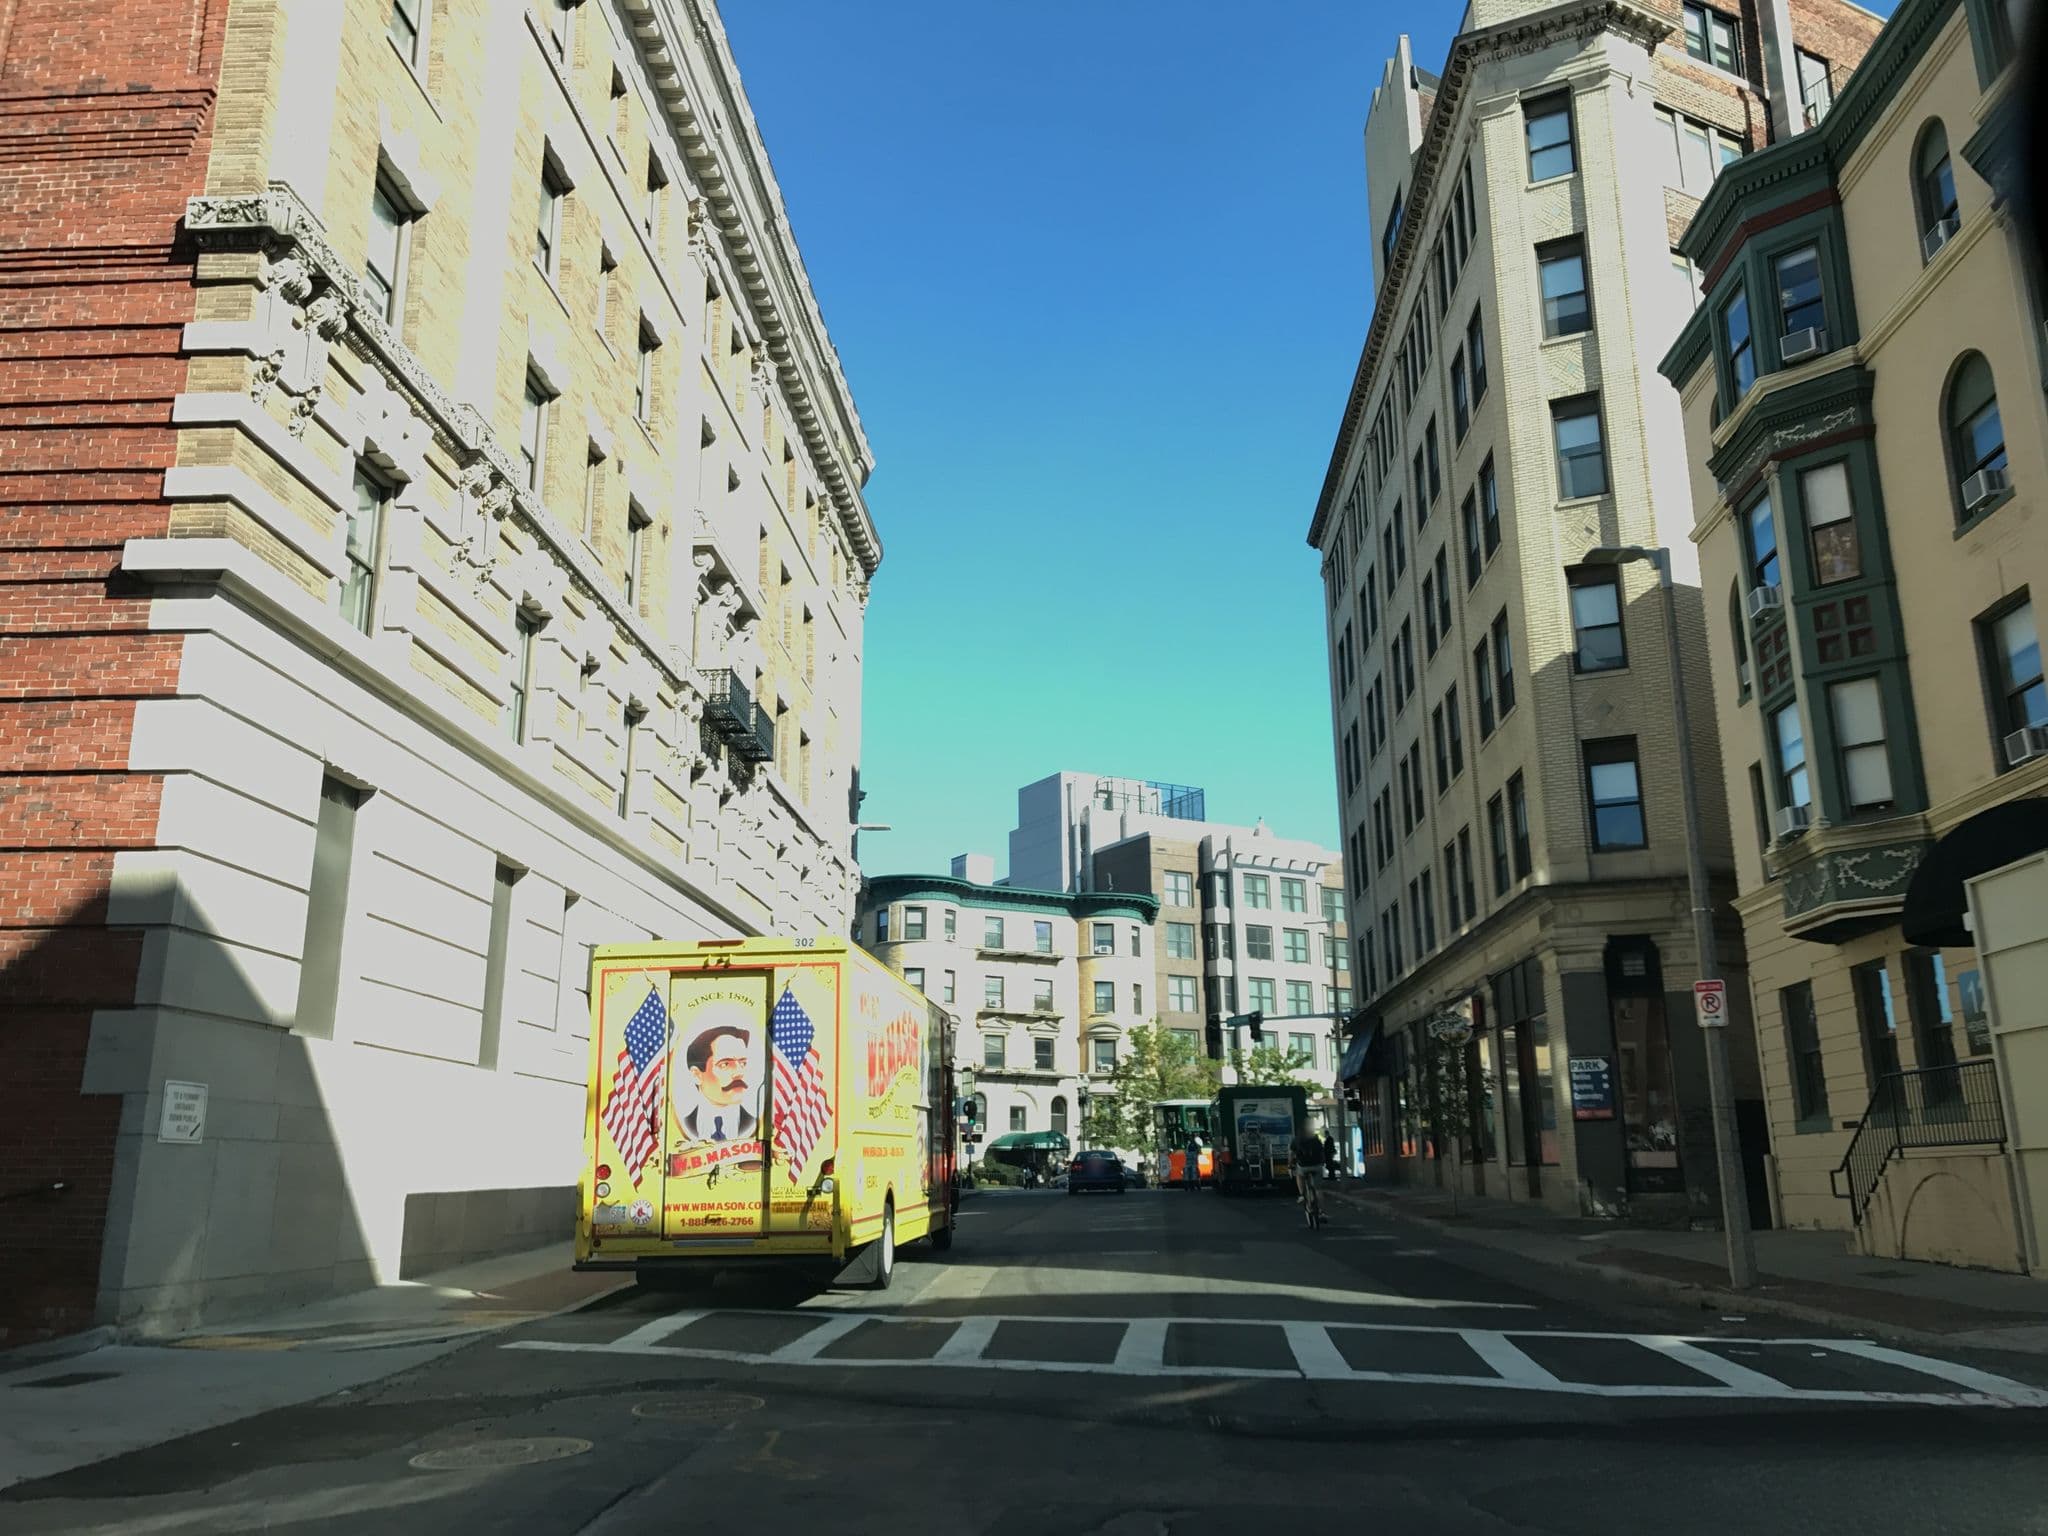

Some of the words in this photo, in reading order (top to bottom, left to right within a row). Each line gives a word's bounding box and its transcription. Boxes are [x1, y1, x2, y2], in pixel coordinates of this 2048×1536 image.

[794, 938, 815, 947] 302
[688, 992, 724, 1009] SINCE
[1571, 1061, 1600, 1070] PARK
[664, 1202, 768, 1213] WWW.WBMASON.CO
